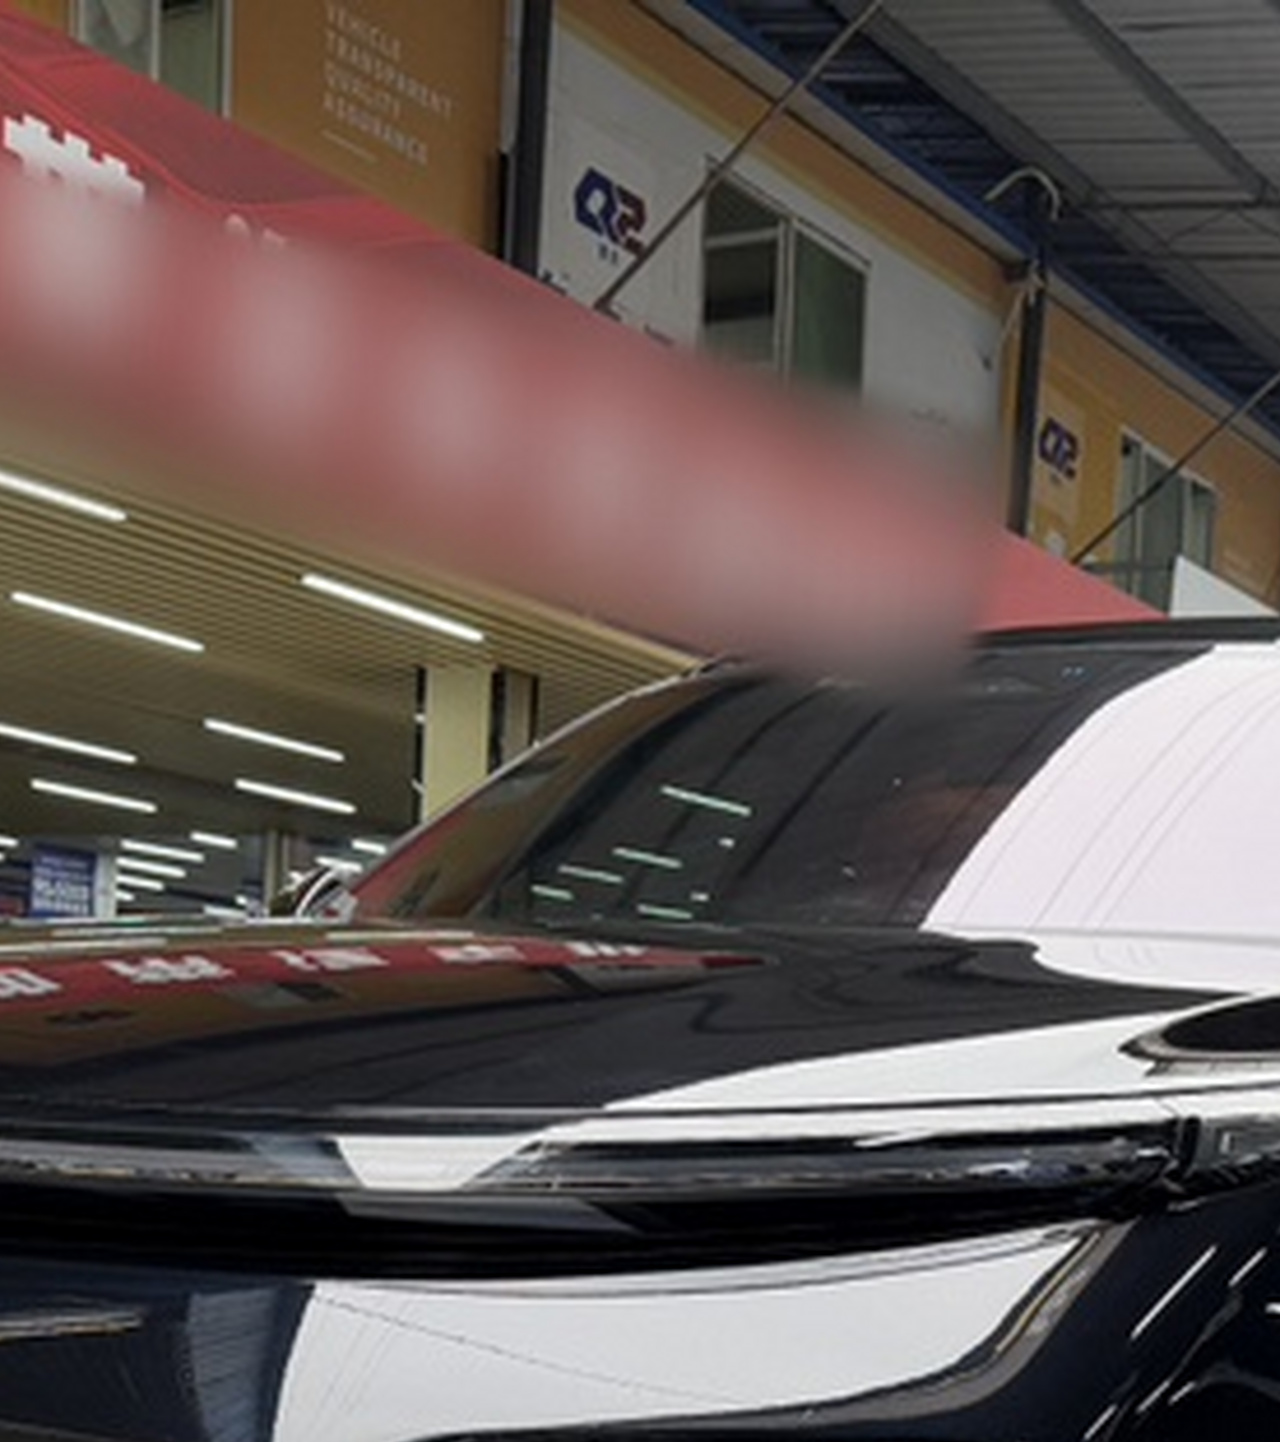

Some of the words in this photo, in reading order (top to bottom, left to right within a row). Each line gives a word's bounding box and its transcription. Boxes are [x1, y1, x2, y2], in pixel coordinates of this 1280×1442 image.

[324, 26, 452, 121] TRANSPARENT
[324, 60, 401, 121] QUALITY
[322, 91, 429, 167] ASSURANCE
